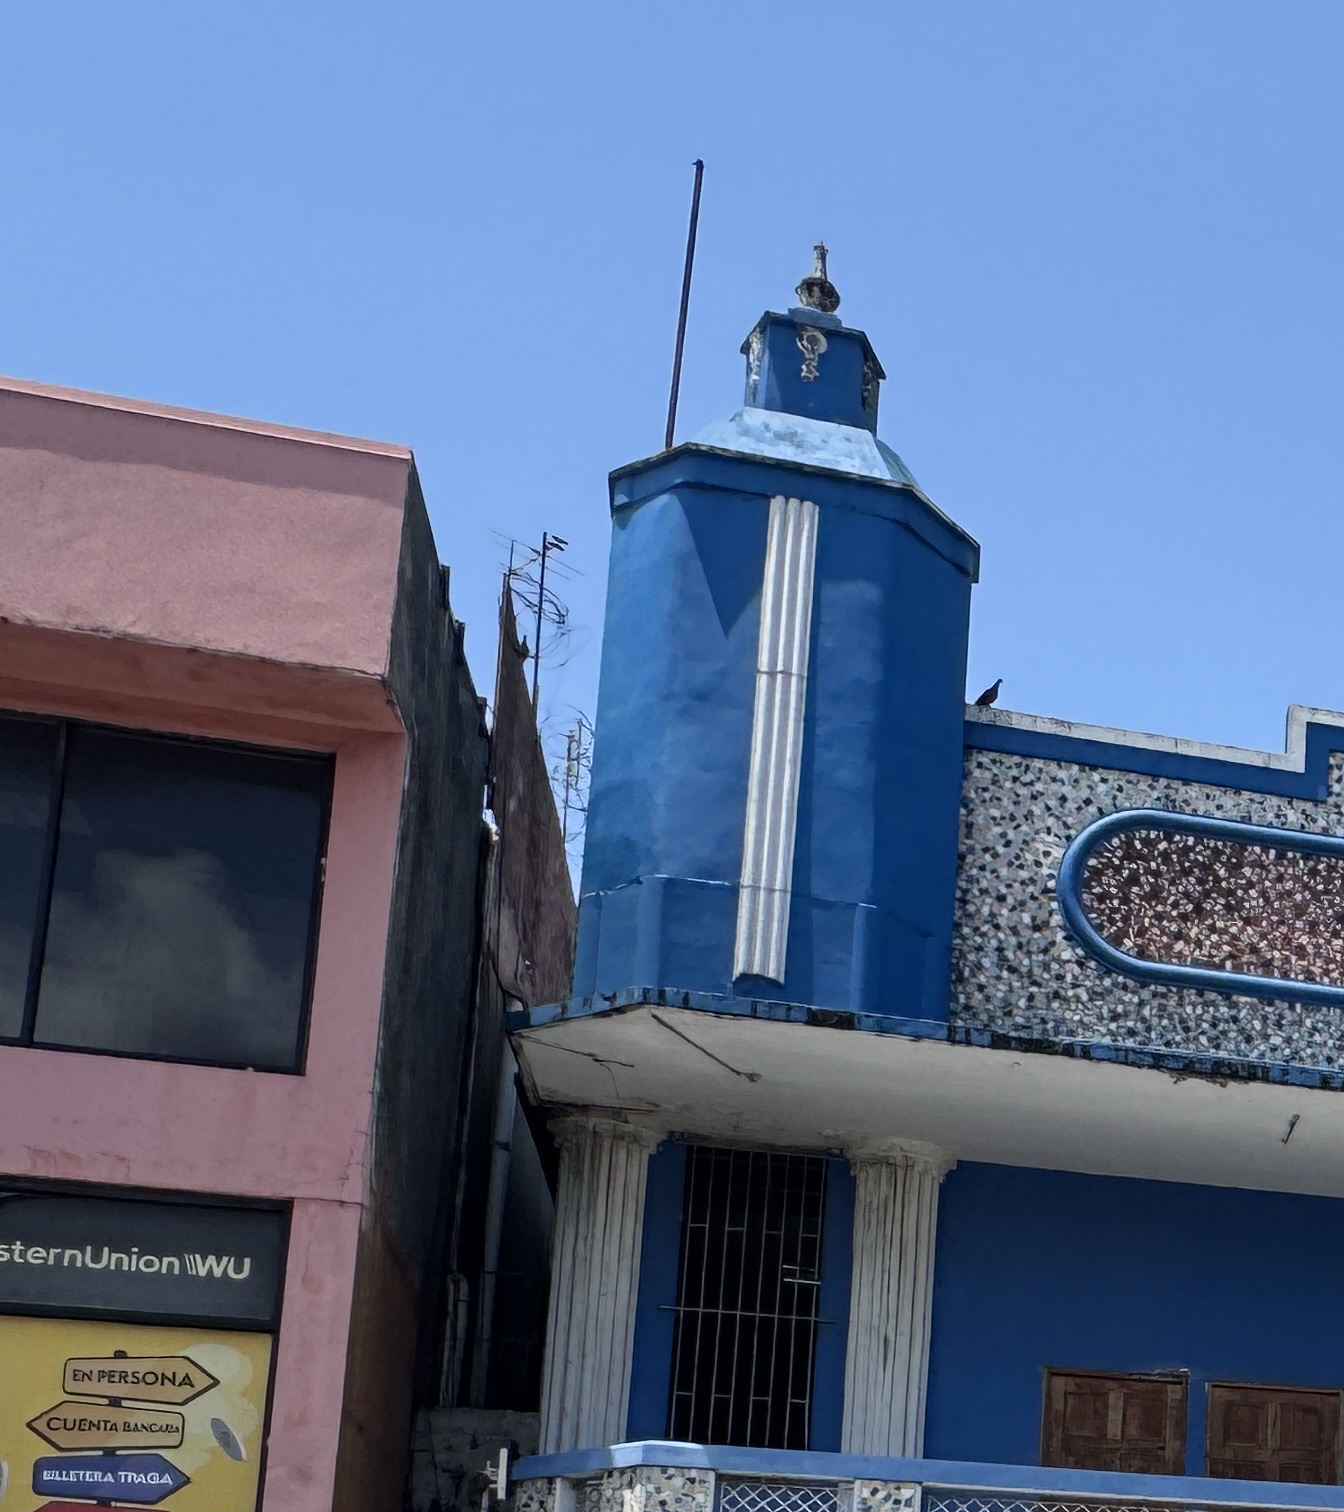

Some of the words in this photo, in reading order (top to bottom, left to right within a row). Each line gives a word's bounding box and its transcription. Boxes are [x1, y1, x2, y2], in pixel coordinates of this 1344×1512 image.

[72, 1369, 93, 1383] EN
[97, 1370, 195, 1388] PERSONA
[46, 1417, 118, 1432] CUENTA
